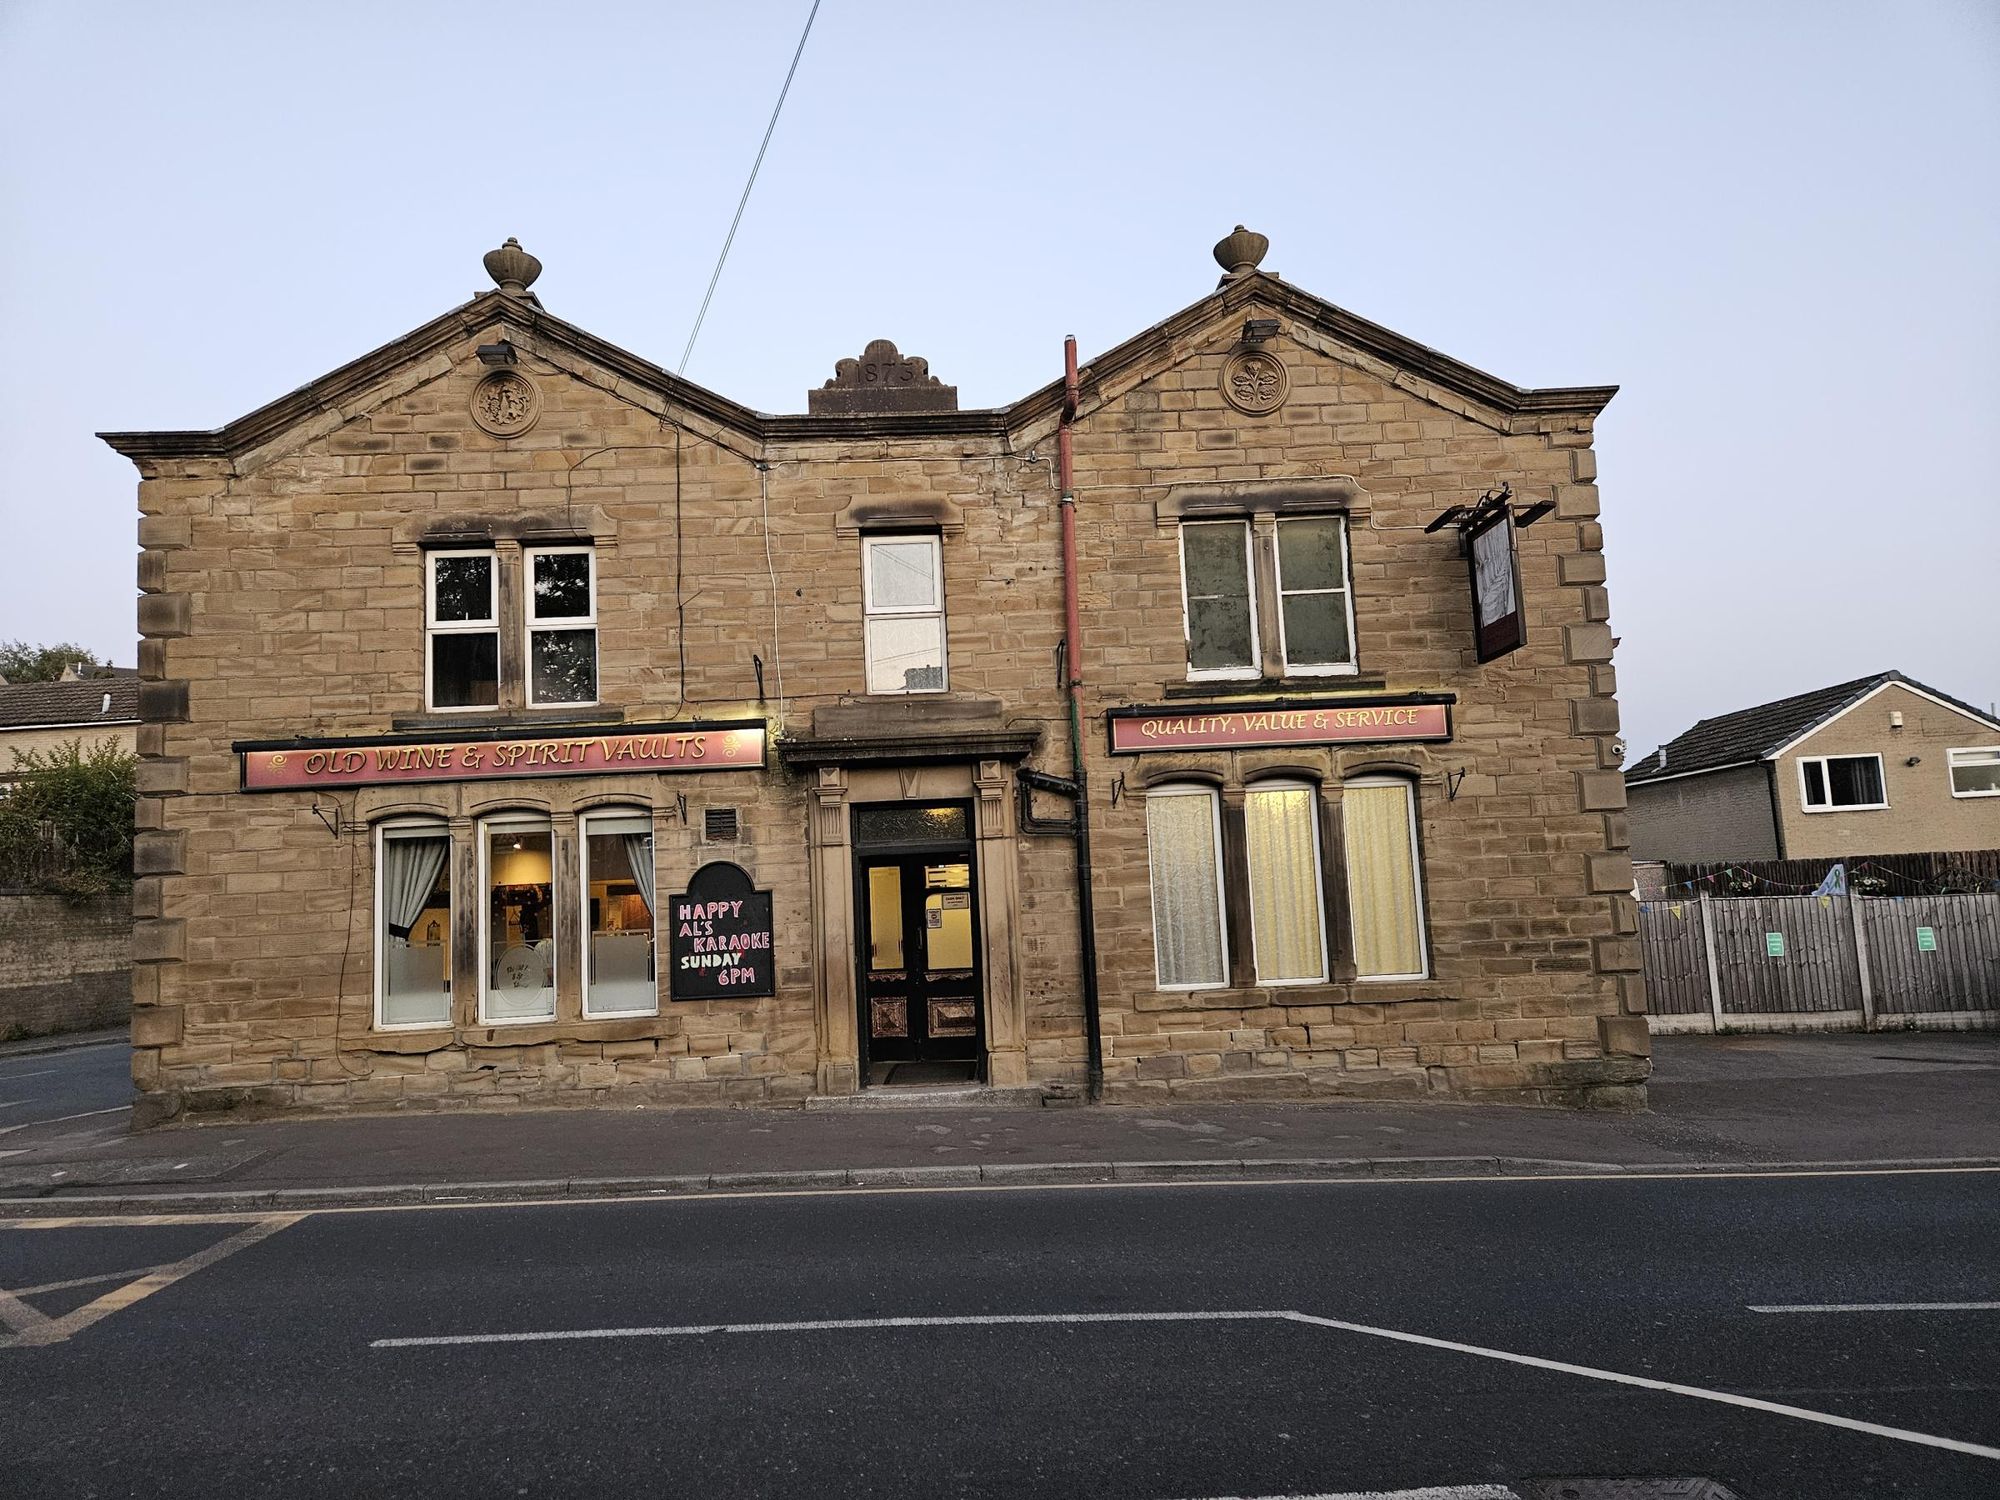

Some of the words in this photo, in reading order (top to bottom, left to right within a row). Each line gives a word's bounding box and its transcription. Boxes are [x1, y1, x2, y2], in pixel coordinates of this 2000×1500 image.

[1141, 716, 1237, 739] QUALITY,
[1242, 713, 1306, 732] VALUE
[1313, 711, 1329, 730] &
[1334, 709, 1418, 729] SERVICE
[304, 750, 367, 775] OLD
[375, 746, 455, 772] WINE
[461, 746, 484, 769] &
[492, 737, 595, 767] SPIRIT
[600, 736, 706, 761] VAULTS
[679, 900, 743, 920] HAPPY
[679, 920, 714, 937] AL'S
[693, 931, 770, 953] KARAOKE
[680, 952, 743, 969] SUNDAY
[718, 967, 755, 985] 6PM
